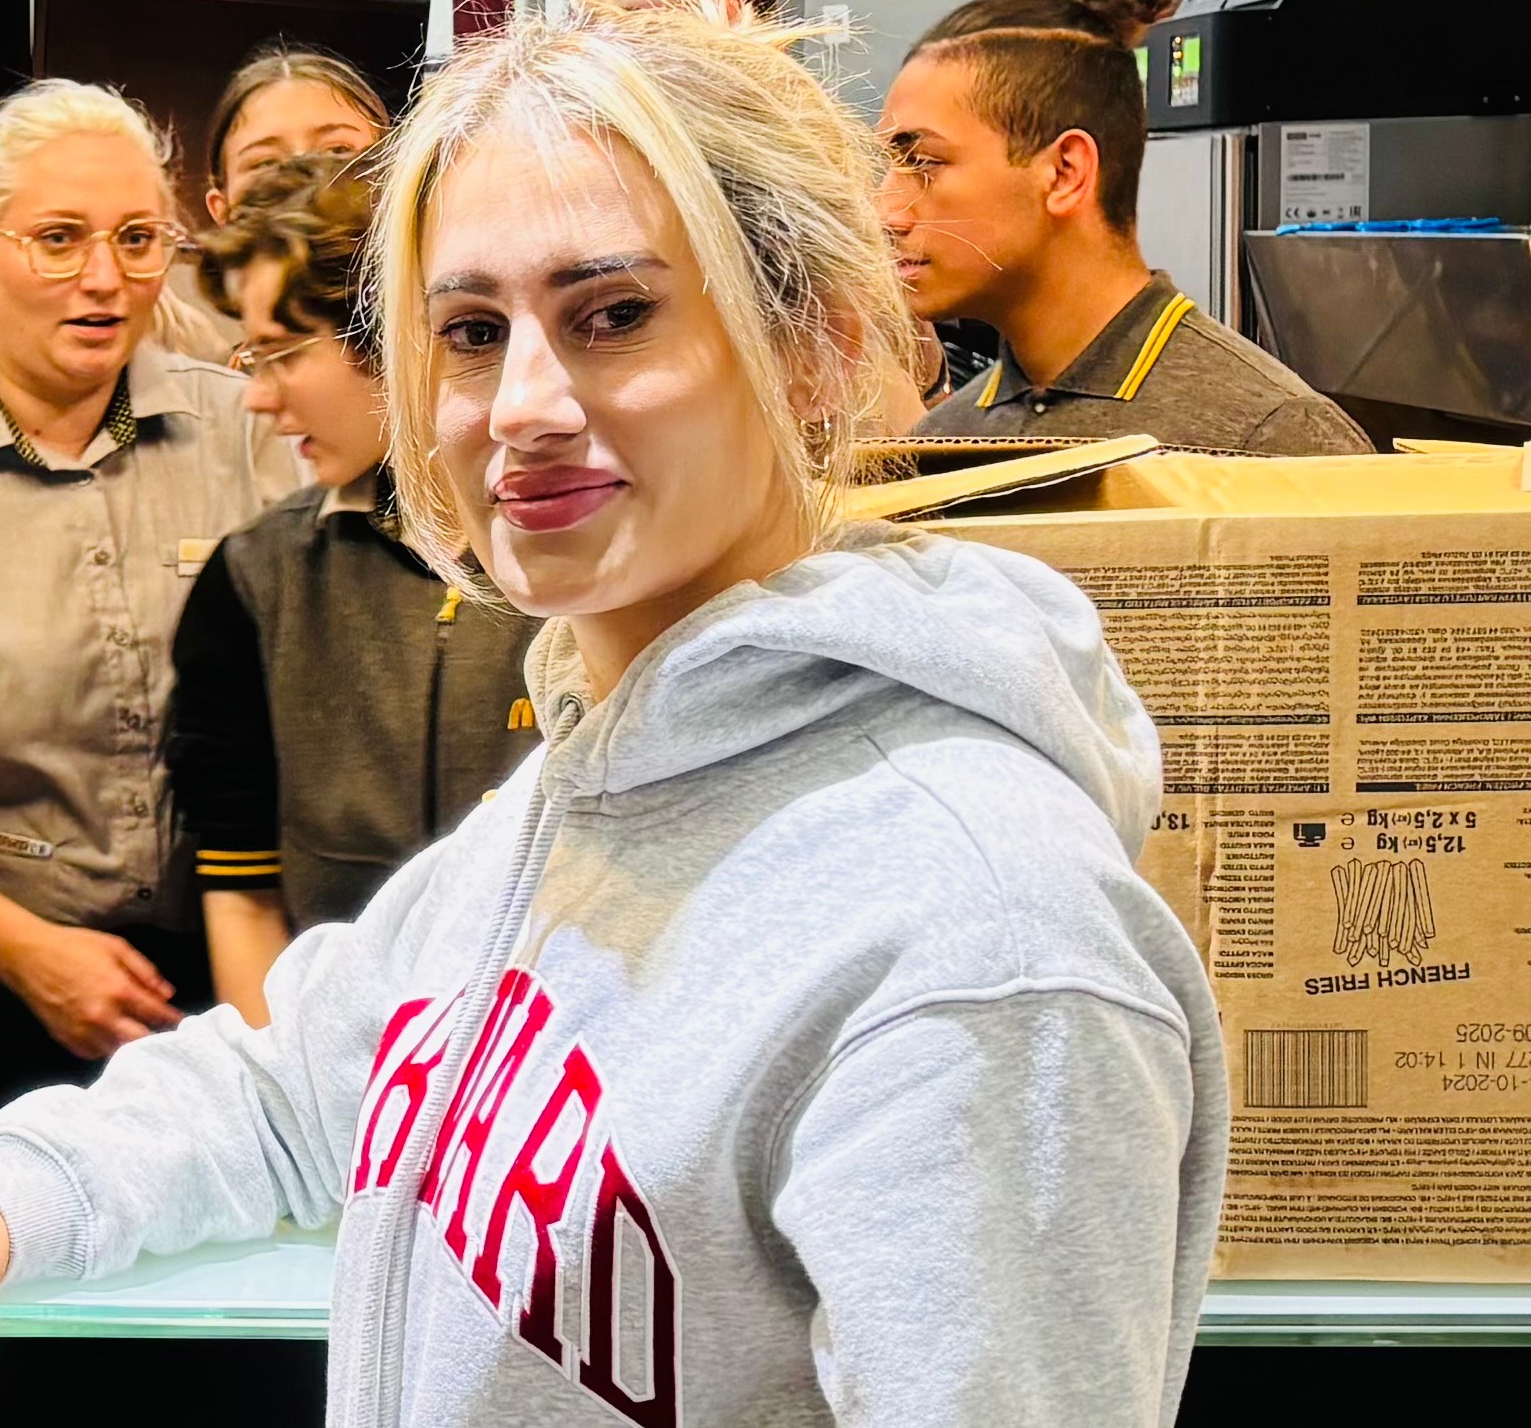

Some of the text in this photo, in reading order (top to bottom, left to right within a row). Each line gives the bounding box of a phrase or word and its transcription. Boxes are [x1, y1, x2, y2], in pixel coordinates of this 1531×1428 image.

[1367, 808, 1389, 829] kg
[1414, 810, 1443, 828] 2,5
[1450, 812, 1458, 824] x
[1466, 811, 1476, 828] 5
[1376, 832, 1399, 853] kg
[1425, 835, 1466, 853] 12,5
[1304, 961, 1471, 996] FRENCH FRIES
[1395, 1052, 1446, 1069] 14:02
[1476, 1052, 1495, 1069] IN
[1442, 1074, 1531, 1091] -10-2024
